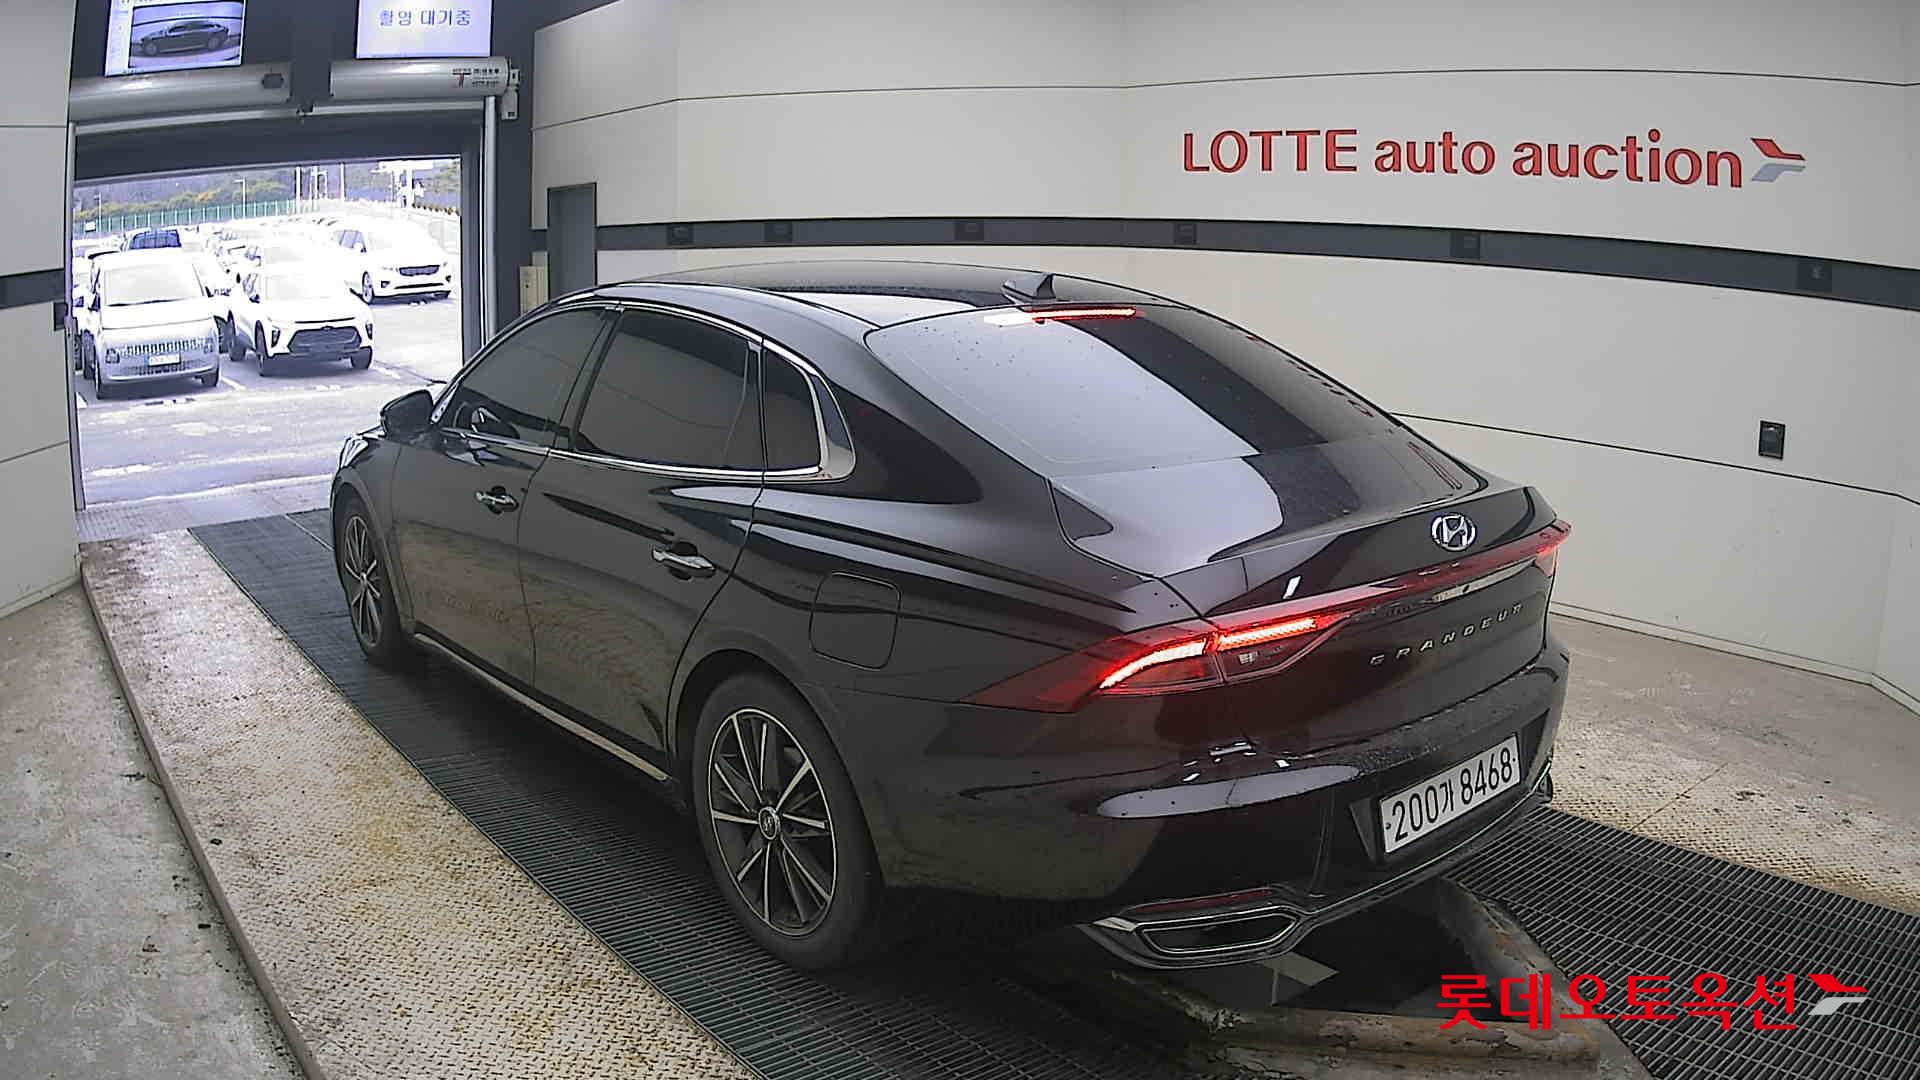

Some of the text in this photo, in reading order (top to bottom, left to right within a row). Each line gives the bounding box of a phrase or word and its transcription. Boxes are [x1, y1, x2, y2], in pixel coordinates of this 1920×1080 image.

[1184, 128, 1744, 189] LOTTE auto auction
[1369, 602, 1523, 666] GRANDEUR
[1459, 747, 1513, 806] 8468
